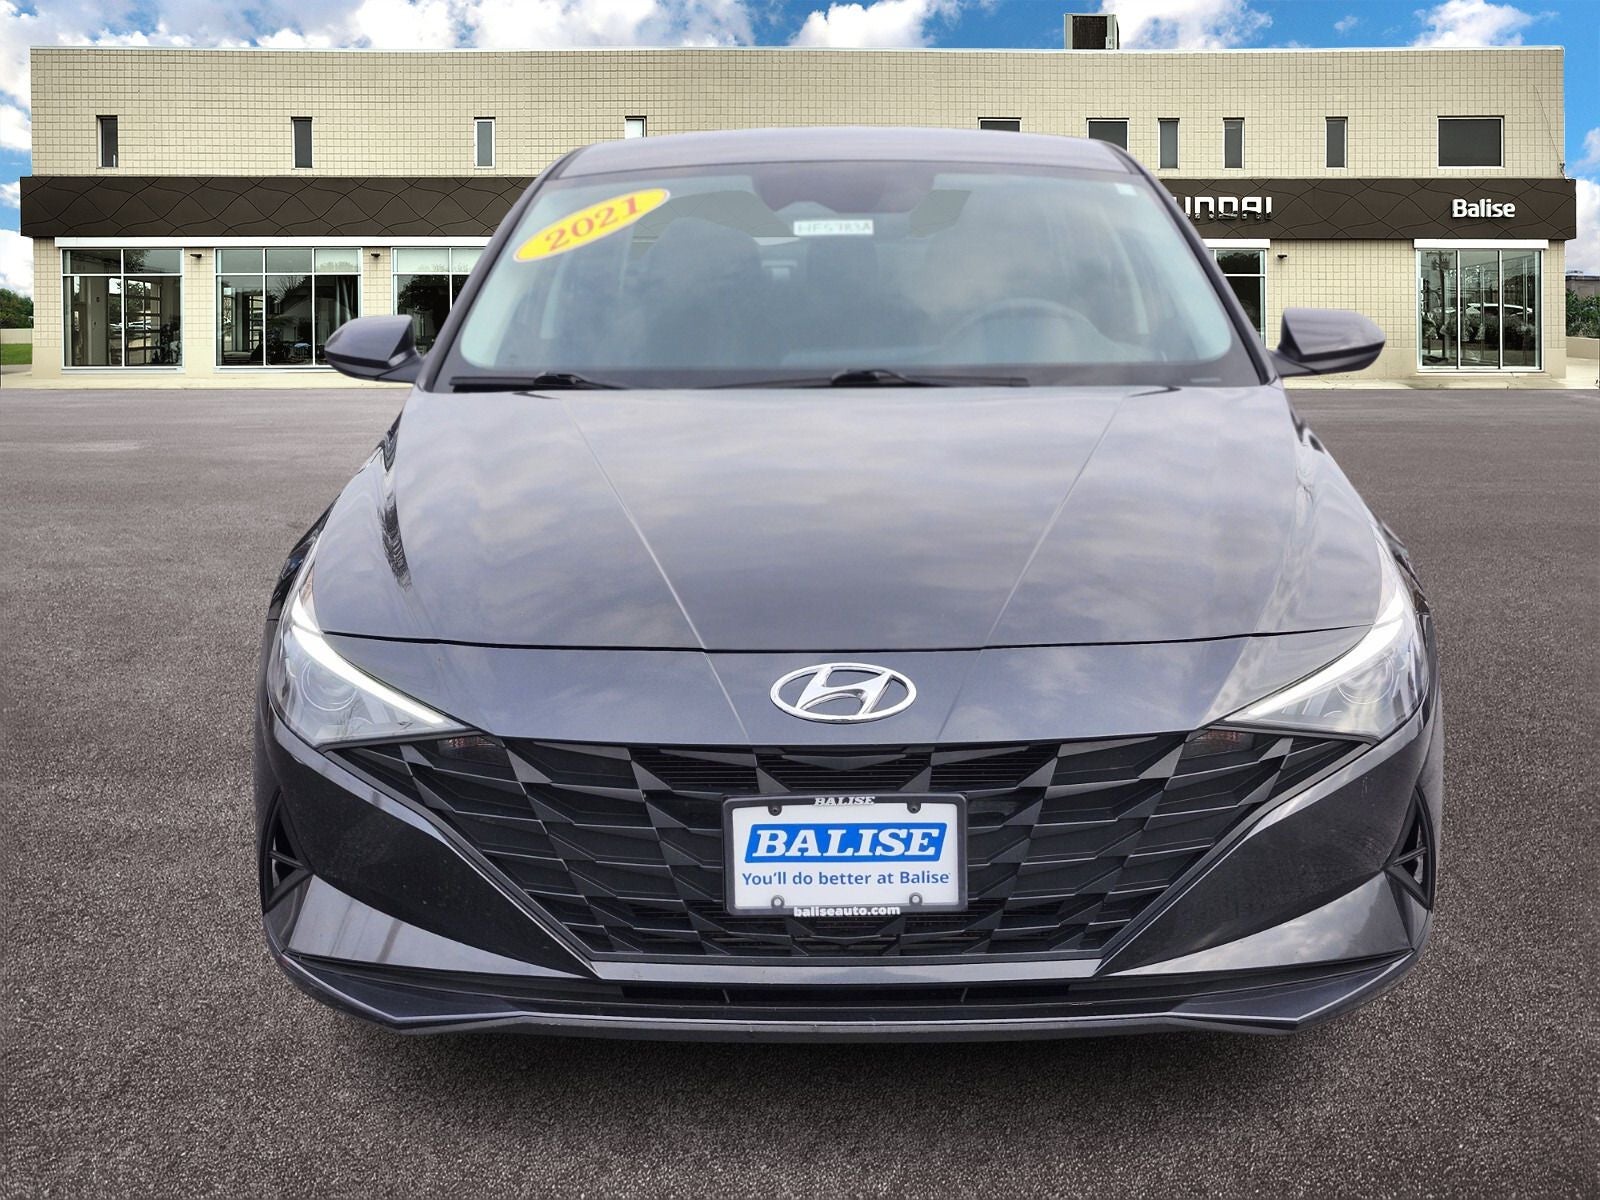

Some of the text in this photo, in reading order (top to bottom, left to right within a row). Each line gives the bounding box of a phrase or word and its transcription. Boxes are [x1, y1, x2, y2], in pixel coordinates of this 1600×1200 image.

[1452, 198, 1516, 218] Balise
[545, 196, 641, 251] 2021
[813, 796, 876, 806] BALISE
[752, 828, 940, 857] BALISE
[742, 870, 950, 885] You'll do better at Balise
[793, 905, 901, 917] baliseauto.com
